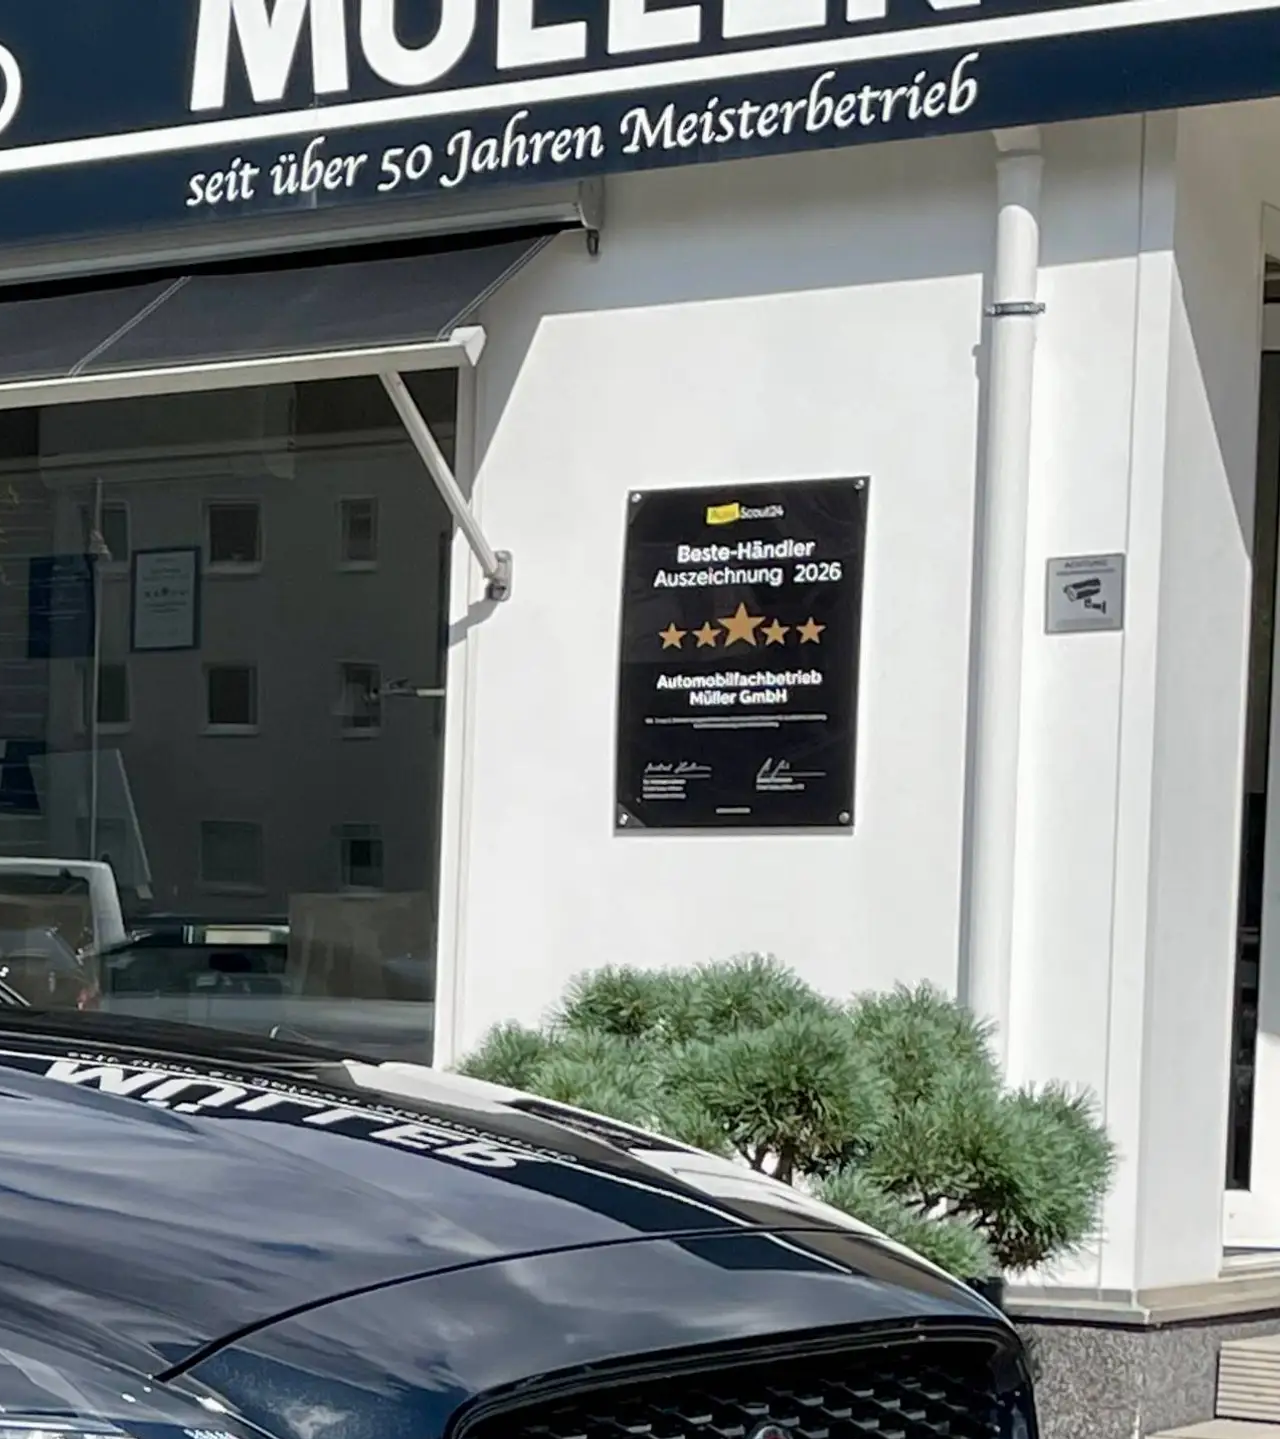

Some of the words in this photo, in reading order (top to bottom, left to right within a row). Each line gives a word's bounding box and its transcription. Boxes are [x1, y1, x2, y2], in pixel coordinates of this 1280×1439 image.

[191, 0, 980, 110] MLL
[187, 158, 260, 206] seit
[271, 137, 368, 195] über
[377, 145, 432, 191] 50
[439, 110, 604, 187] Jahren
[620, 52, 979, 154] Meisterbetrieb
[677, 539, 815, 563] Beste-Händler
[654, 566, 783, 587] Auszeichnung
[794, 562, 842, 582] 2026
[657, 669, 823, 690] Automobilfachbetrieb
[690, 689, 738, 707] Müller
[739, 688, 788, 706] GmbH
